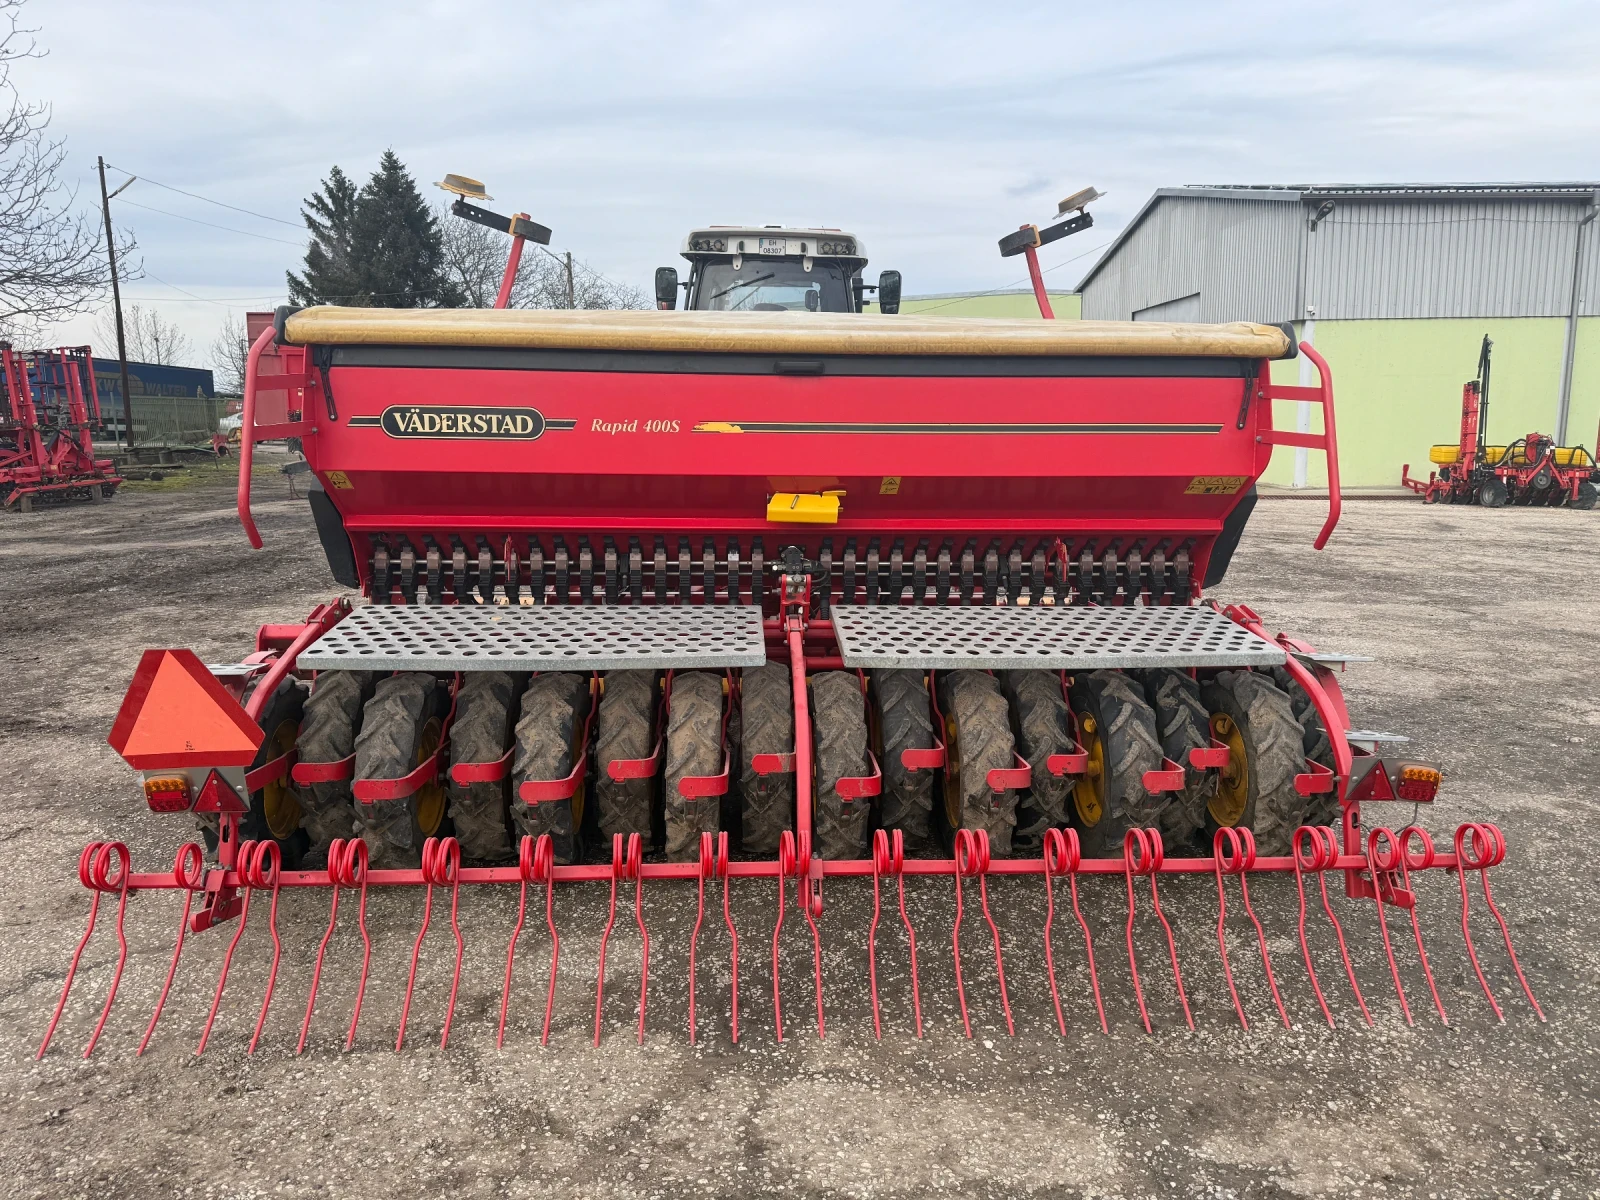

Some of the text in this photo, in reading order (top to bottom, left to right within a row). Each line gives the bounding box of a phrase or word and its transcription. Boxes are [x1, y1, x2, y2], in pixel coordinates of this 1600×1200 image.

[146, 382, 187, 397] WALTER
[392, 408, 534, 434] VÄDERSTAD
[591, 418, 681, 436] Rapid 400S
